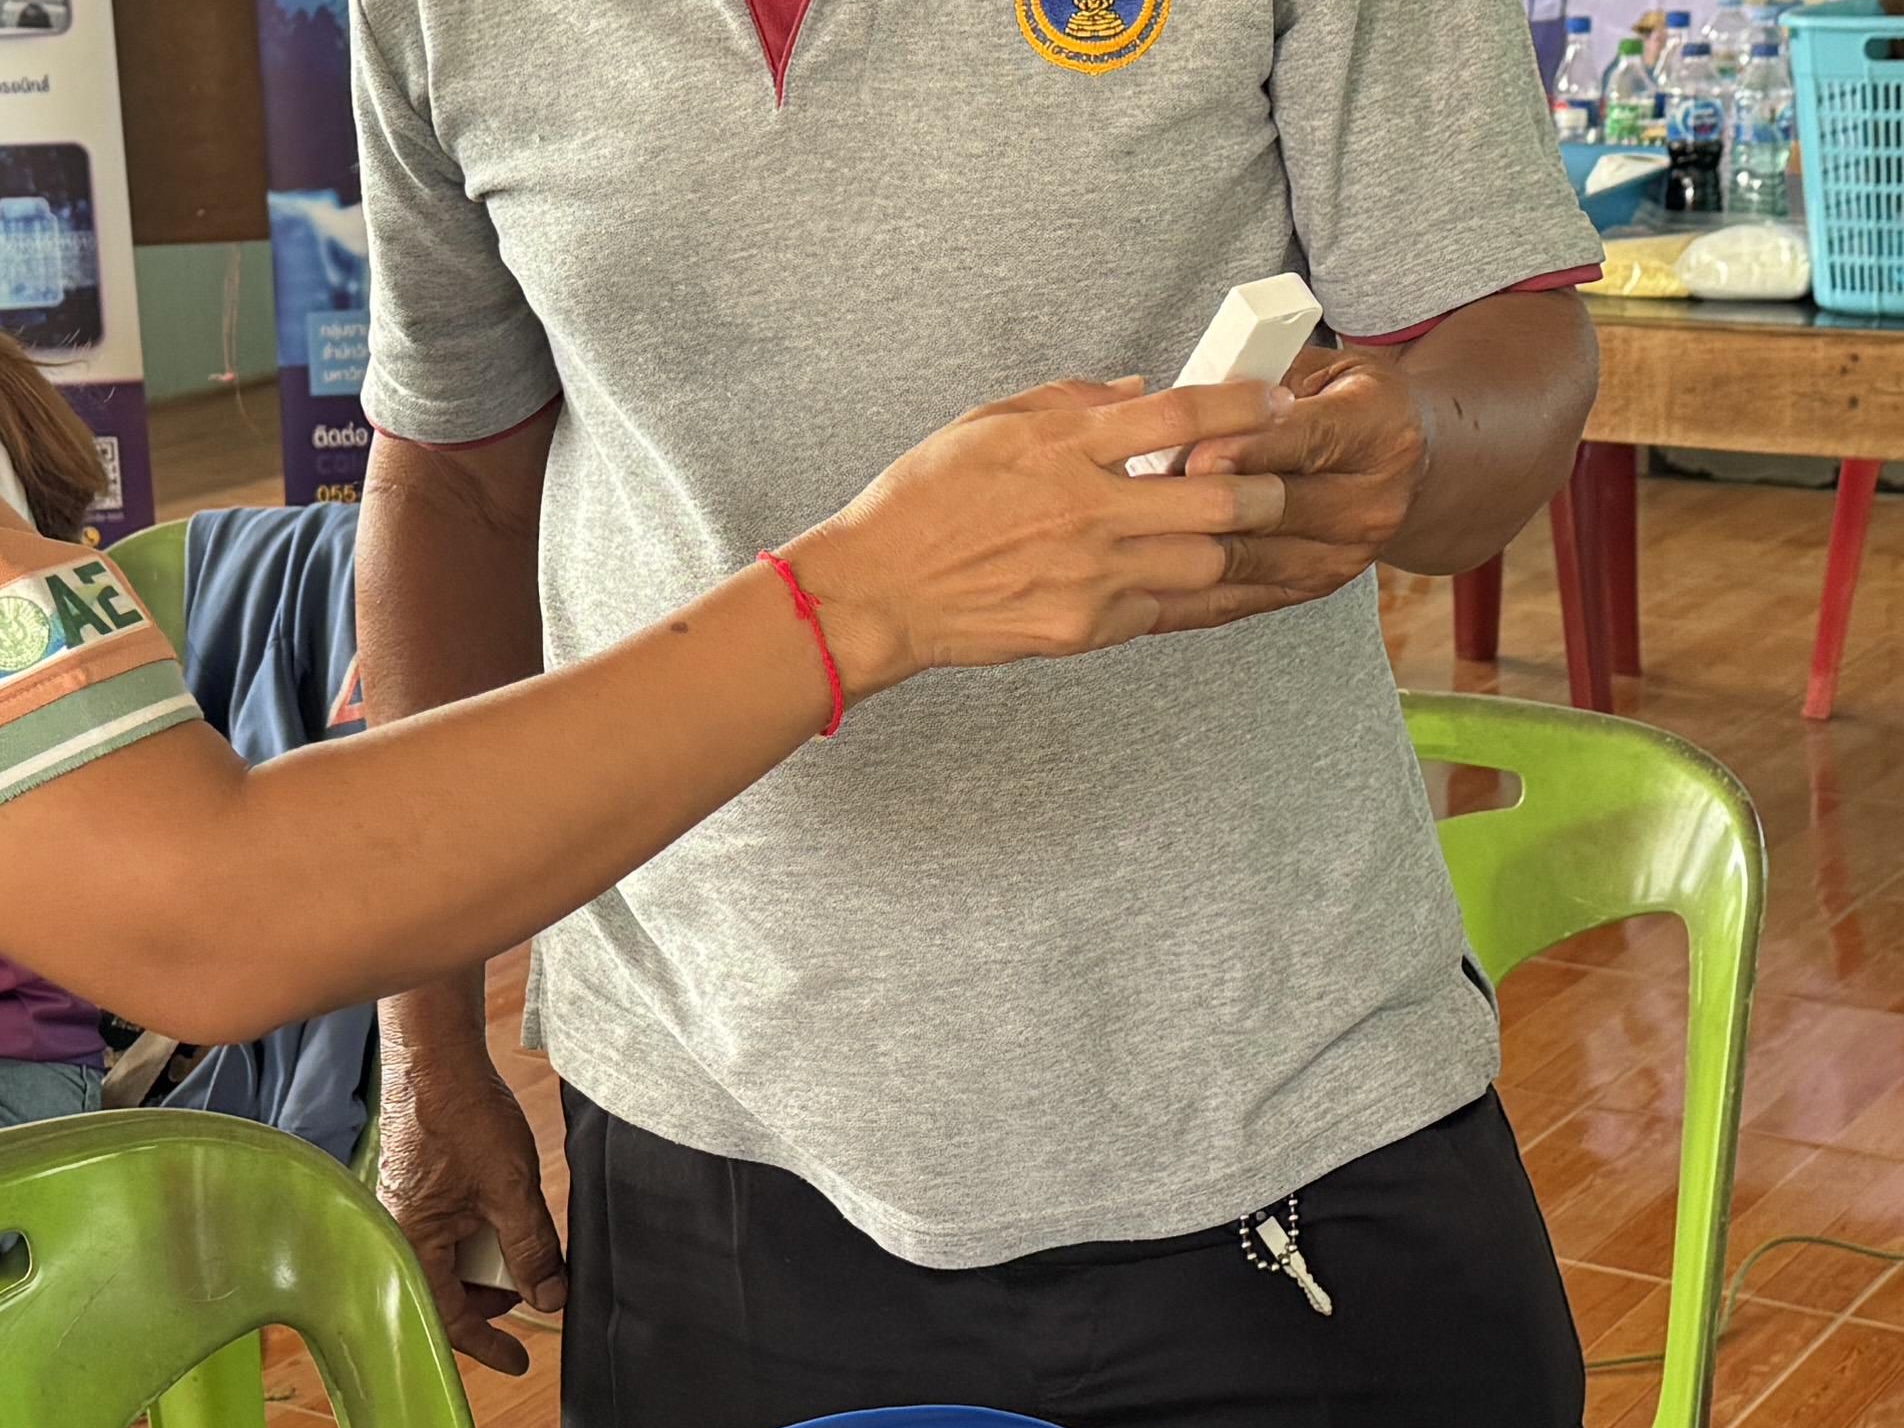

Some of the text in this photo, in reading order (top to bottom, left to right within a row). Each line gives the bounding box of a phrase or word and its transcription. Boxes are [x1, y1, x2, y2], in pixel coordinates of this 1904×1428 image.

[312, 422, 369, 449] ติดต่อ
[315, 484, 360, 503] 055
